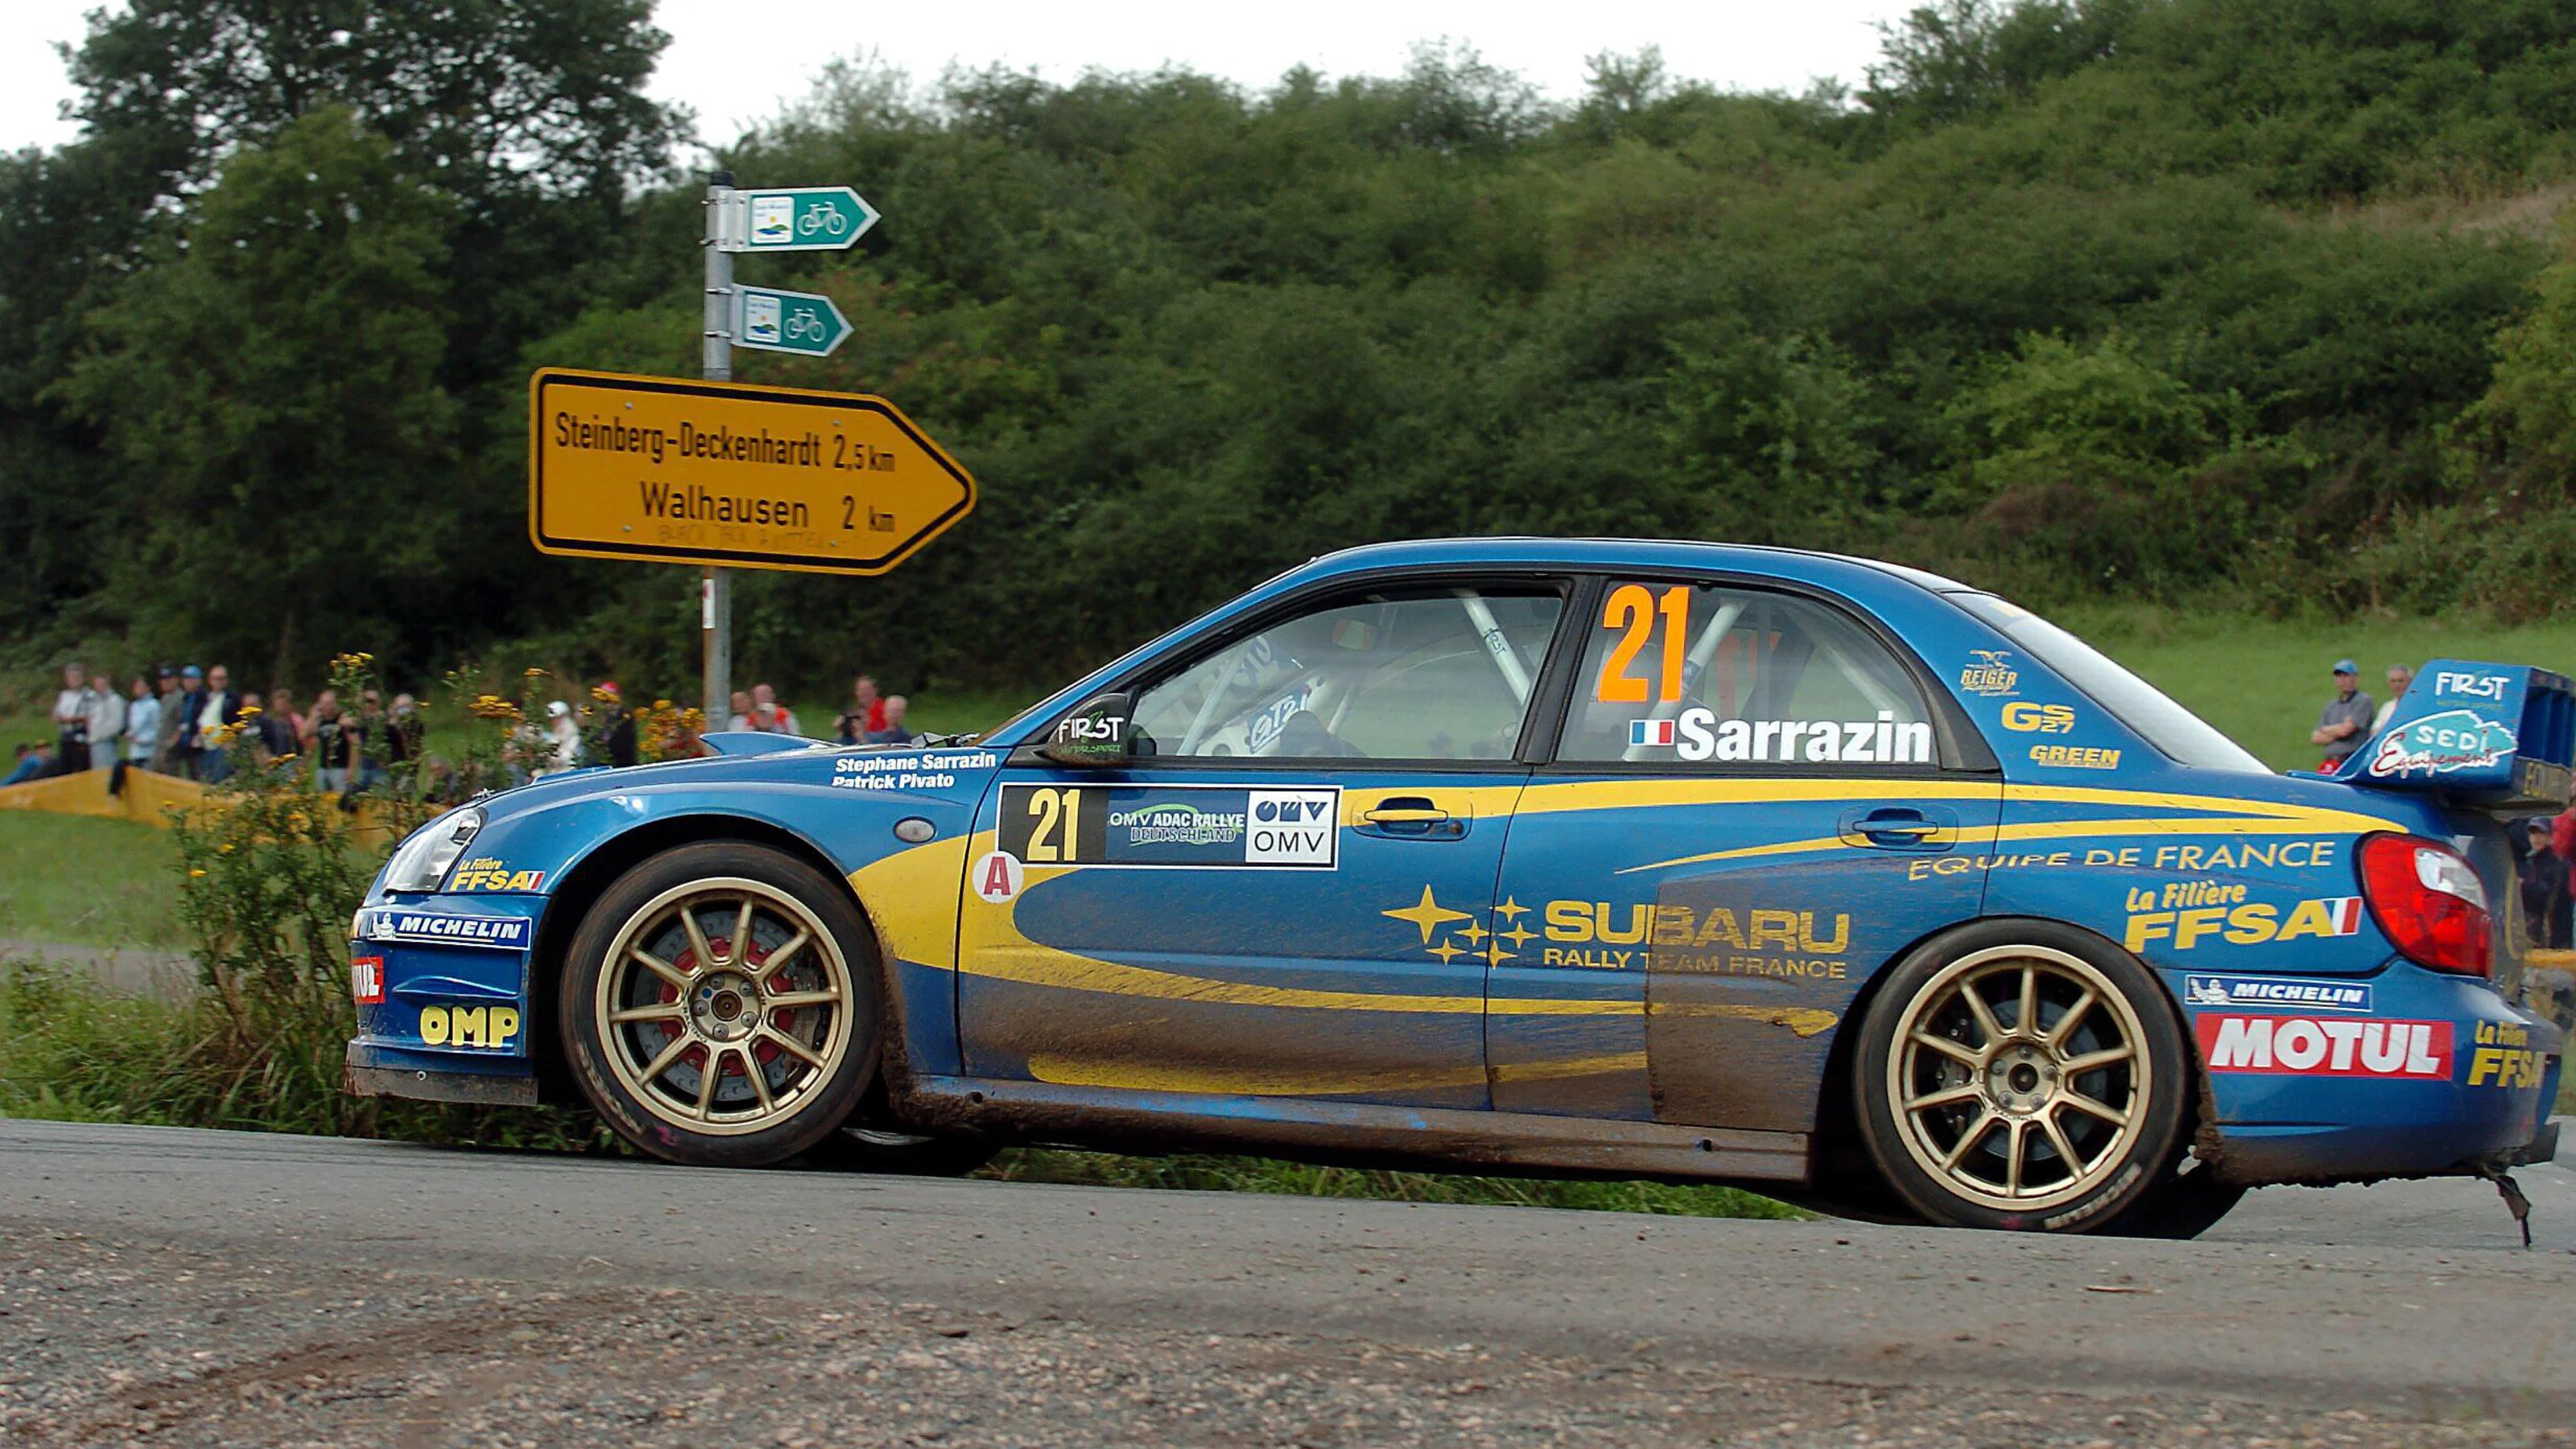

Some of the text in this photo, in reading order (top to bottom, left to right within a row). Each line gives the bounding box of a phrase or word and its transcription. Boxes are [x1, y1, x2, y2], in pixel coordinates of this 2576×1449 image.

[555, 411, 896, 473] Steinberg-Deckenhardt 2,5 km
[641, 481, 896, 533] Walhausen 2 km
[1596, 584, 1689, 703] 21
[1961, 669, 2019, 686] REIGER
[2434, 672, 2510, 700] FIRST
[1058, 716, 1125, 744] FIRST
[2001, 701, 2075, 733] GS
[2040, 720, 2075, 734] 27
[1677, 708, 1931, 762] Sarrazin
[836, 751, 997, 774] Stephane Sarrazin
[2029, 745, 2121, 764] GREEN
[832, 773, 956, 789] Patrick Pivato
[1027, 787, 1081, 861] 21
[1110, 812, 1245, 828] OMV ADAC RALLYE
[1131, 827, 1236, 843] DEUTSCHLAND
[1254, 831, 1325, 853] OMV
[984, 857, 1010, 895] A
[1908, 841, 2335, 881] EQUIPE DE FRANCE
[449, 870, 530, 891] FFSA
[2125, 879, 2247, 912] La Filière
[398, 916, 522, 939] MICHELIN
[1545, 899, 1850, 955] SUBARU
[2124, 898, 2336, 953] FFSA
[1544, 947, 1846, 980] RALLY TEAM FRANCE
[2232, 982, 2364, 1003] MICHELIN
[419, 1005, 519, 1049] OMP
[2209, 1018, 2442, 1075] MOTUL
[2467, 1047, 2545, 1089] FFSA
